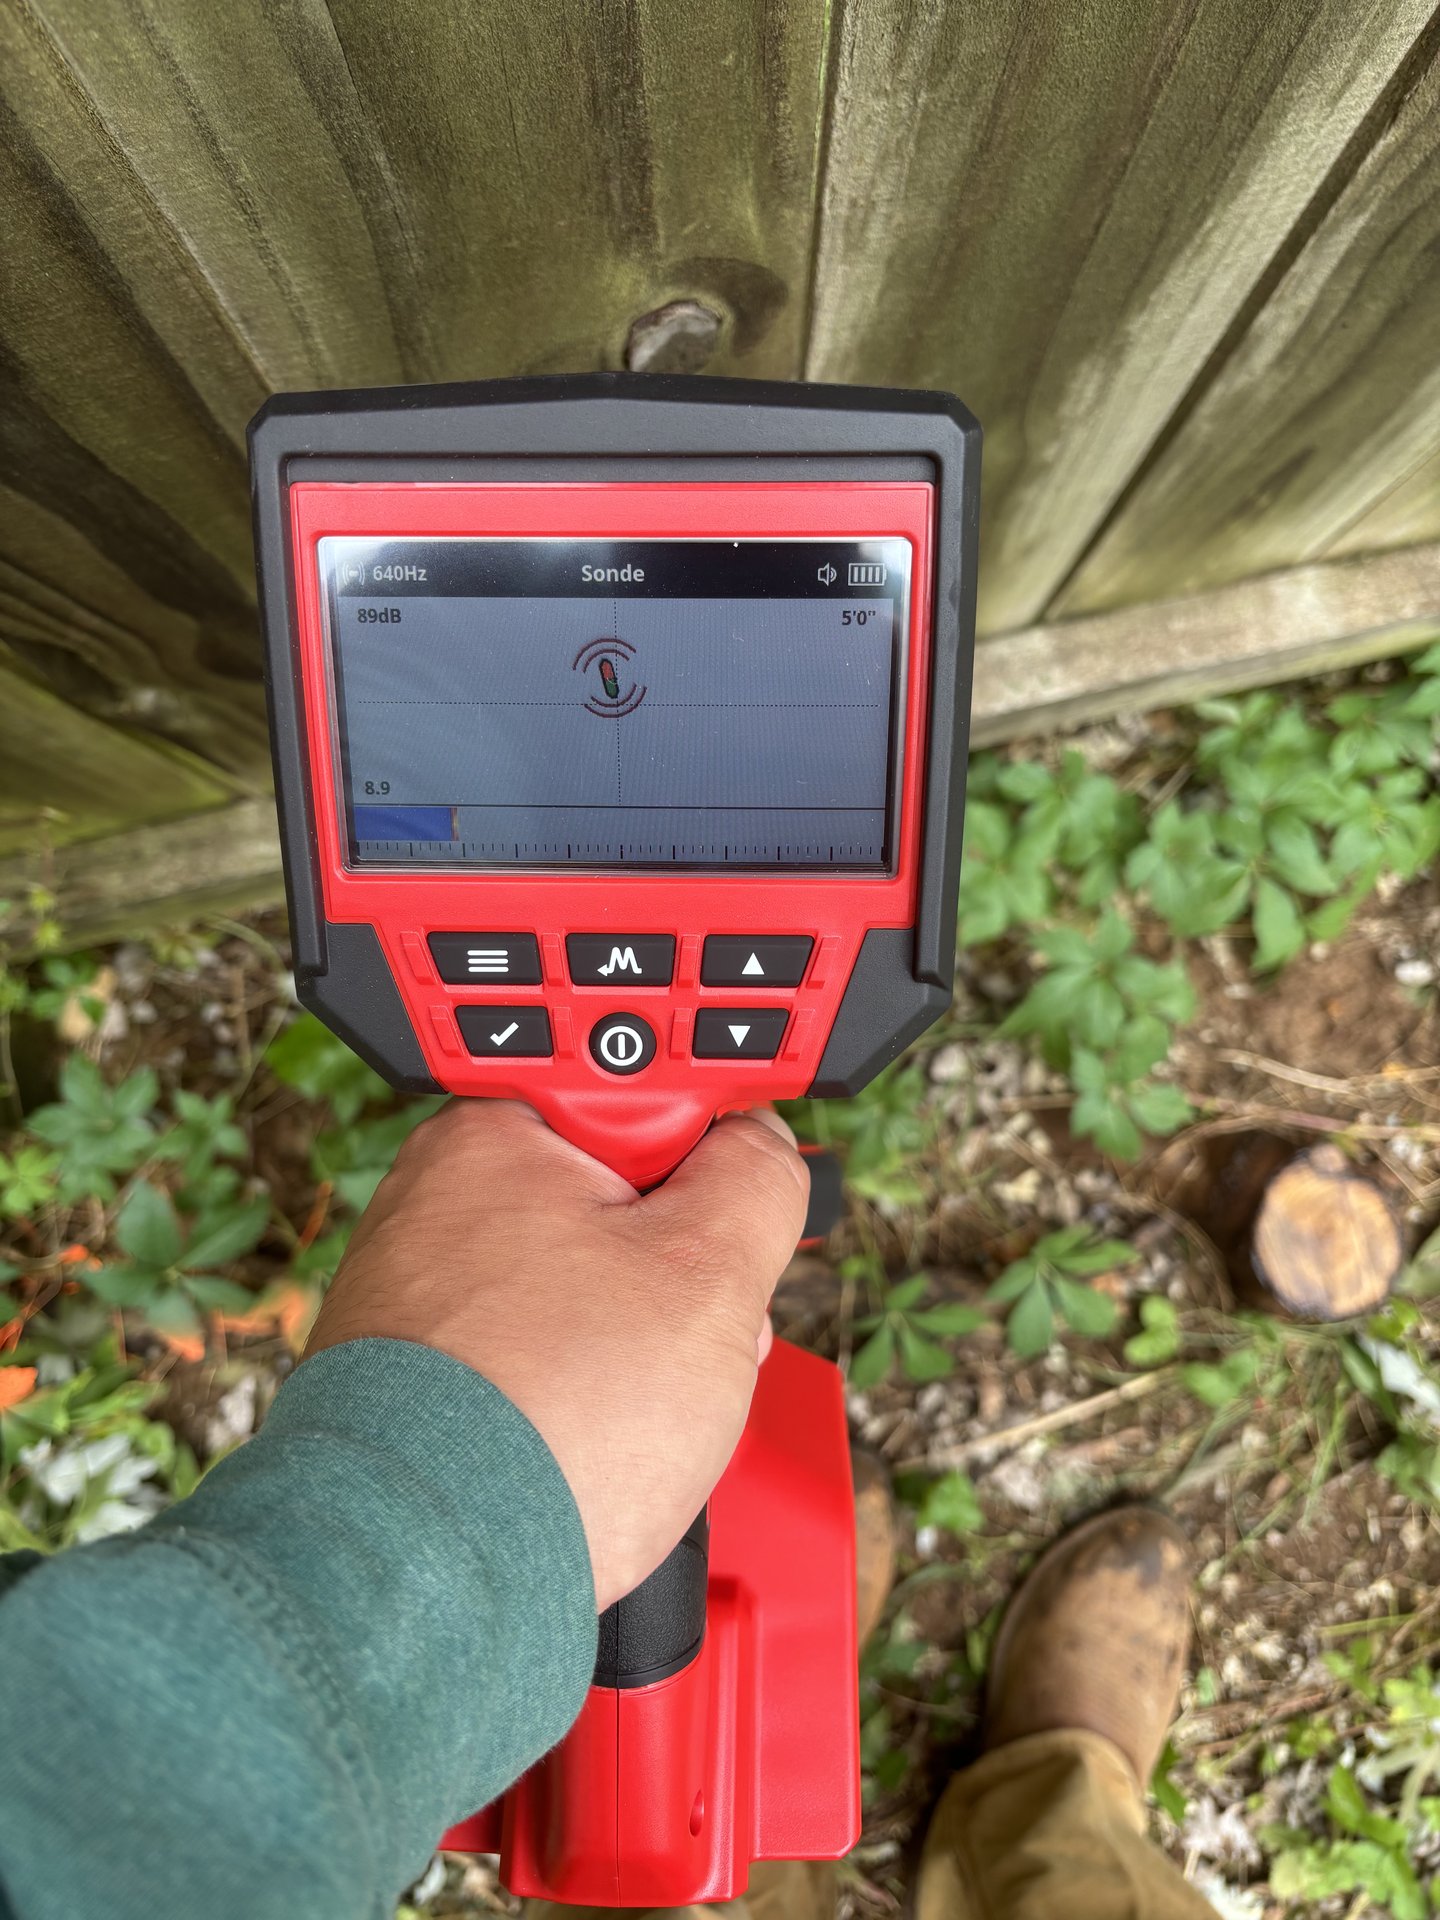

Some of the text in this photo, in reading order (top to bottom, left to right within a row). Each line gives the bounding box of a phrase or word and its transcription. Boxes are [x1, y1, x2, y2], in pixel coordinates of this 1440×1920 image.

[373, 565, 427, 581] 640Hz
[581, 564, 645, 582] Sonde
[357, 608, 401, 624] 89dB
[841, 610, 876, 626] 5'0"
[365, 781, 390, 795] 8.9
